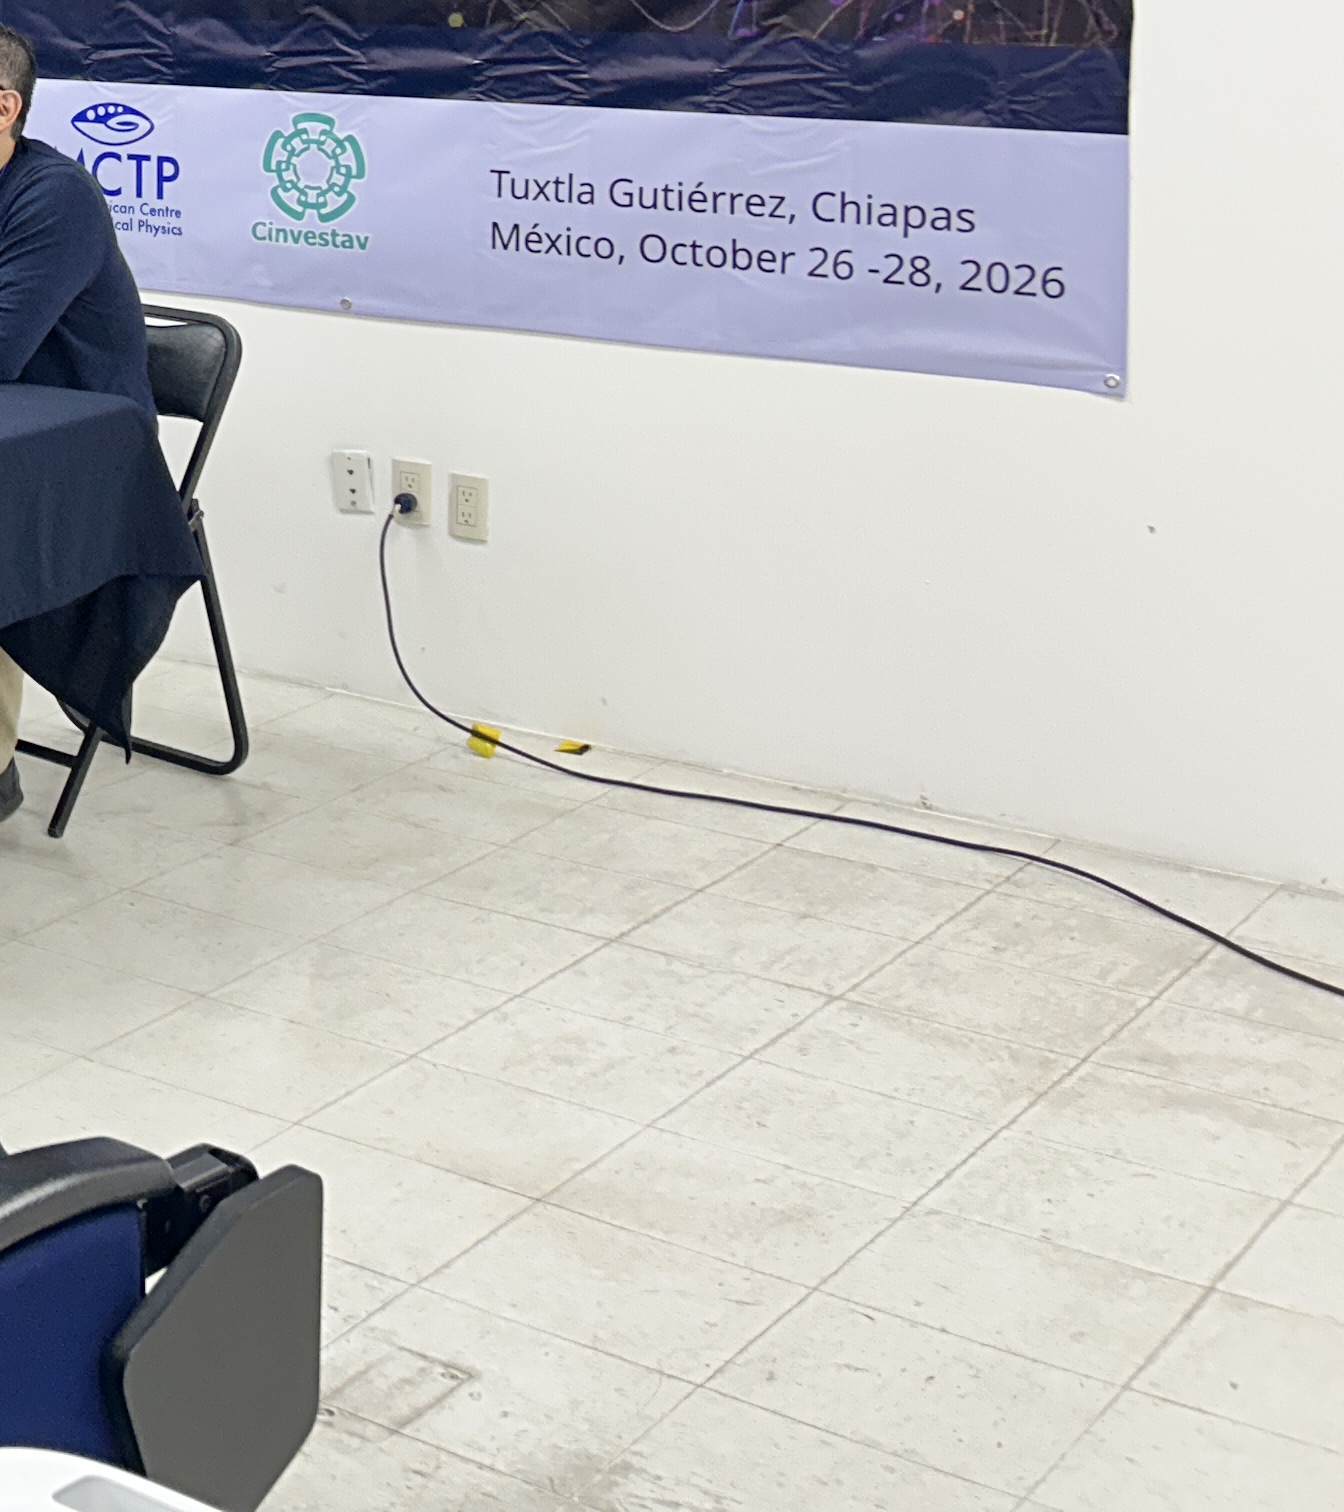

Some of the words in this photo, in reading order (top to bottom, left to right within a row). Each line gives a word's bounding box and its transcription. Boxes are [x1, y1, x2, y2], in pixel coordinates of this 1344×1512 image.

[140, 202, 182, 219] Centre
[490, 169, 596, 205] Tuxtla
[608, 178, 796, 225] Gutiérrez,
[811, 191, 977, 239] Chiapas
[137, 218, 184, 238] Physics
[250, 220, 370, 251] Cinvestav
[490, 221, 626, 266] México,
[638, 233, 797, 275] October
[806, 246, 855, 281] 26
[867, 252, 943, 294] -28,
[958, 259, 1066, 300] 2026
